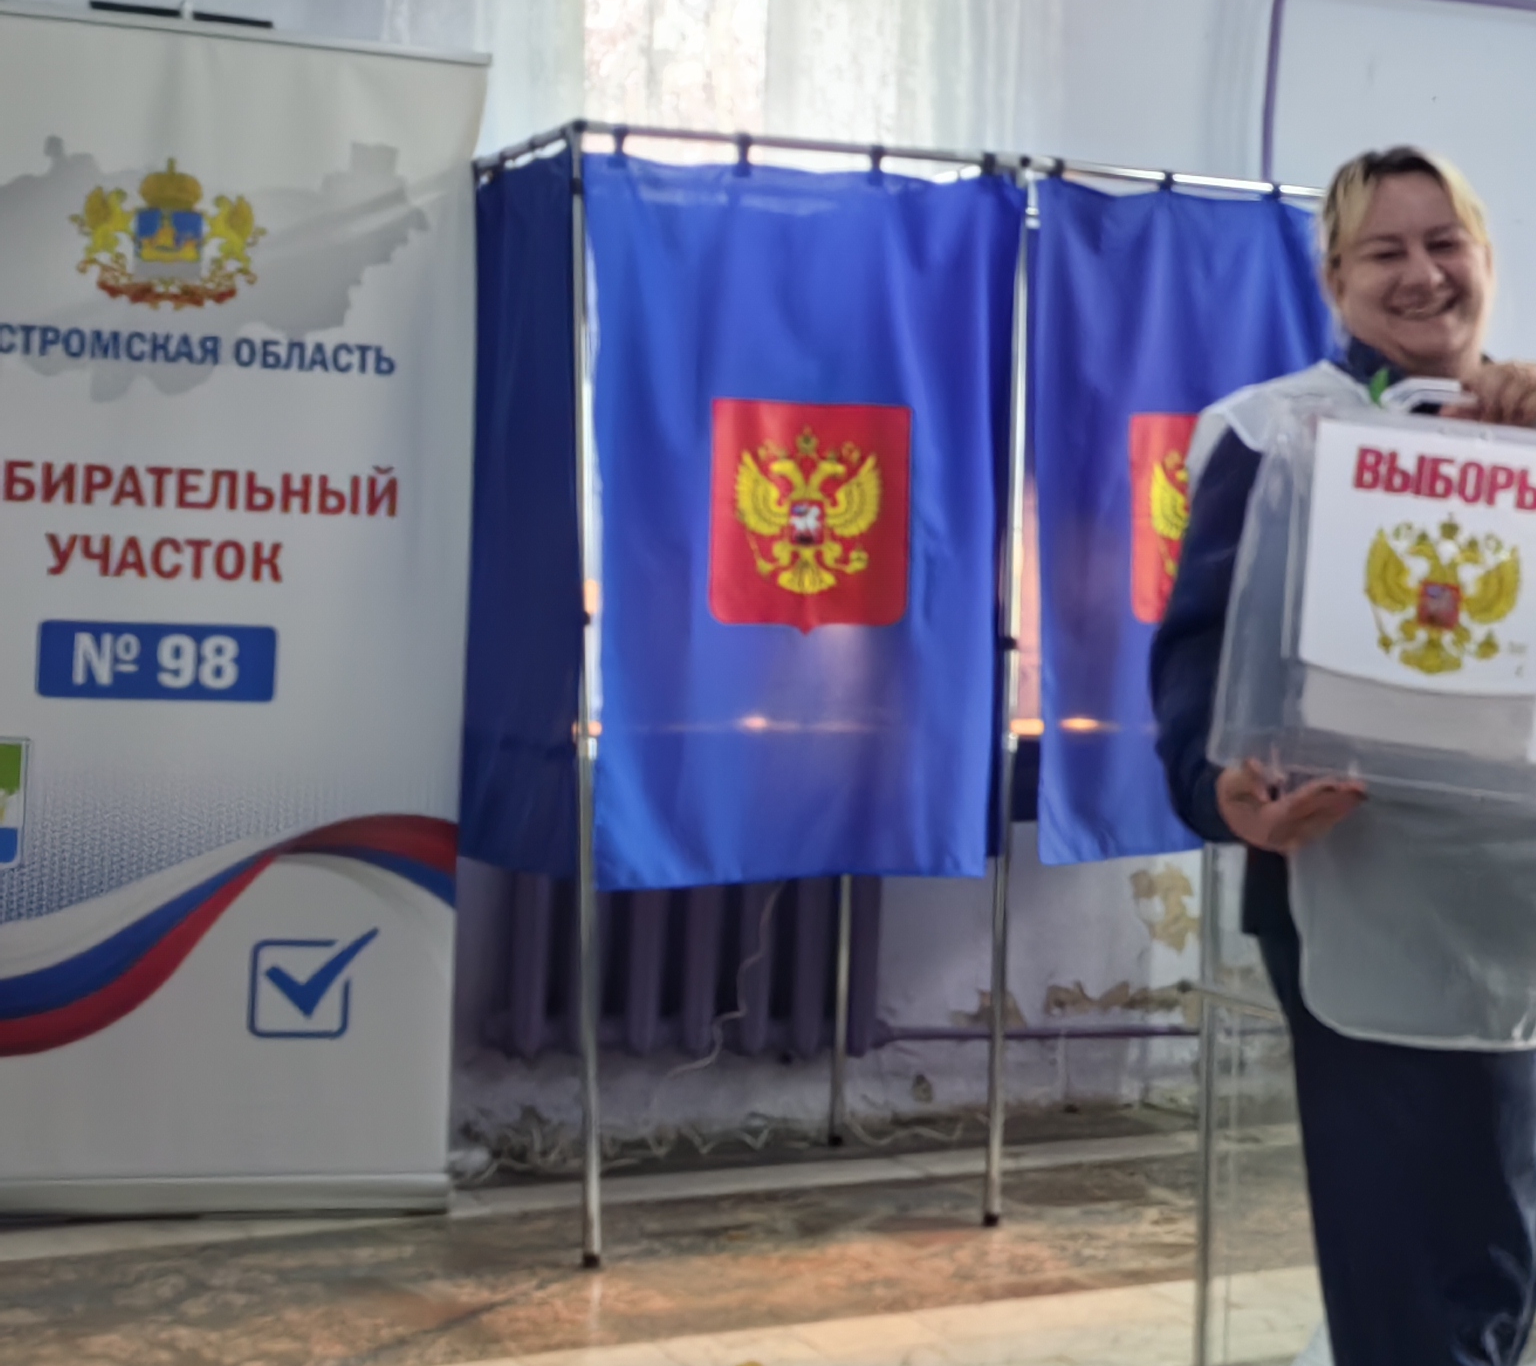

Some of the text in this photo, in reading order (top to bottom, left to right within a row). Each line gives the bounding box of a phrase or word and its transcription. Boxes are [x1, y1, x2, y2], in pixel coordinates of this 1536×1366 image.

[0, 323, 396, 376] СТРОМСКАЯ ОБЛАСТЬ
[2, 460, 398, 517] БИРАТЕЛЬНЫЙ
[45, 533, 283, 583] УЧАСТОК
[72, 632, 239, 690] № 98
